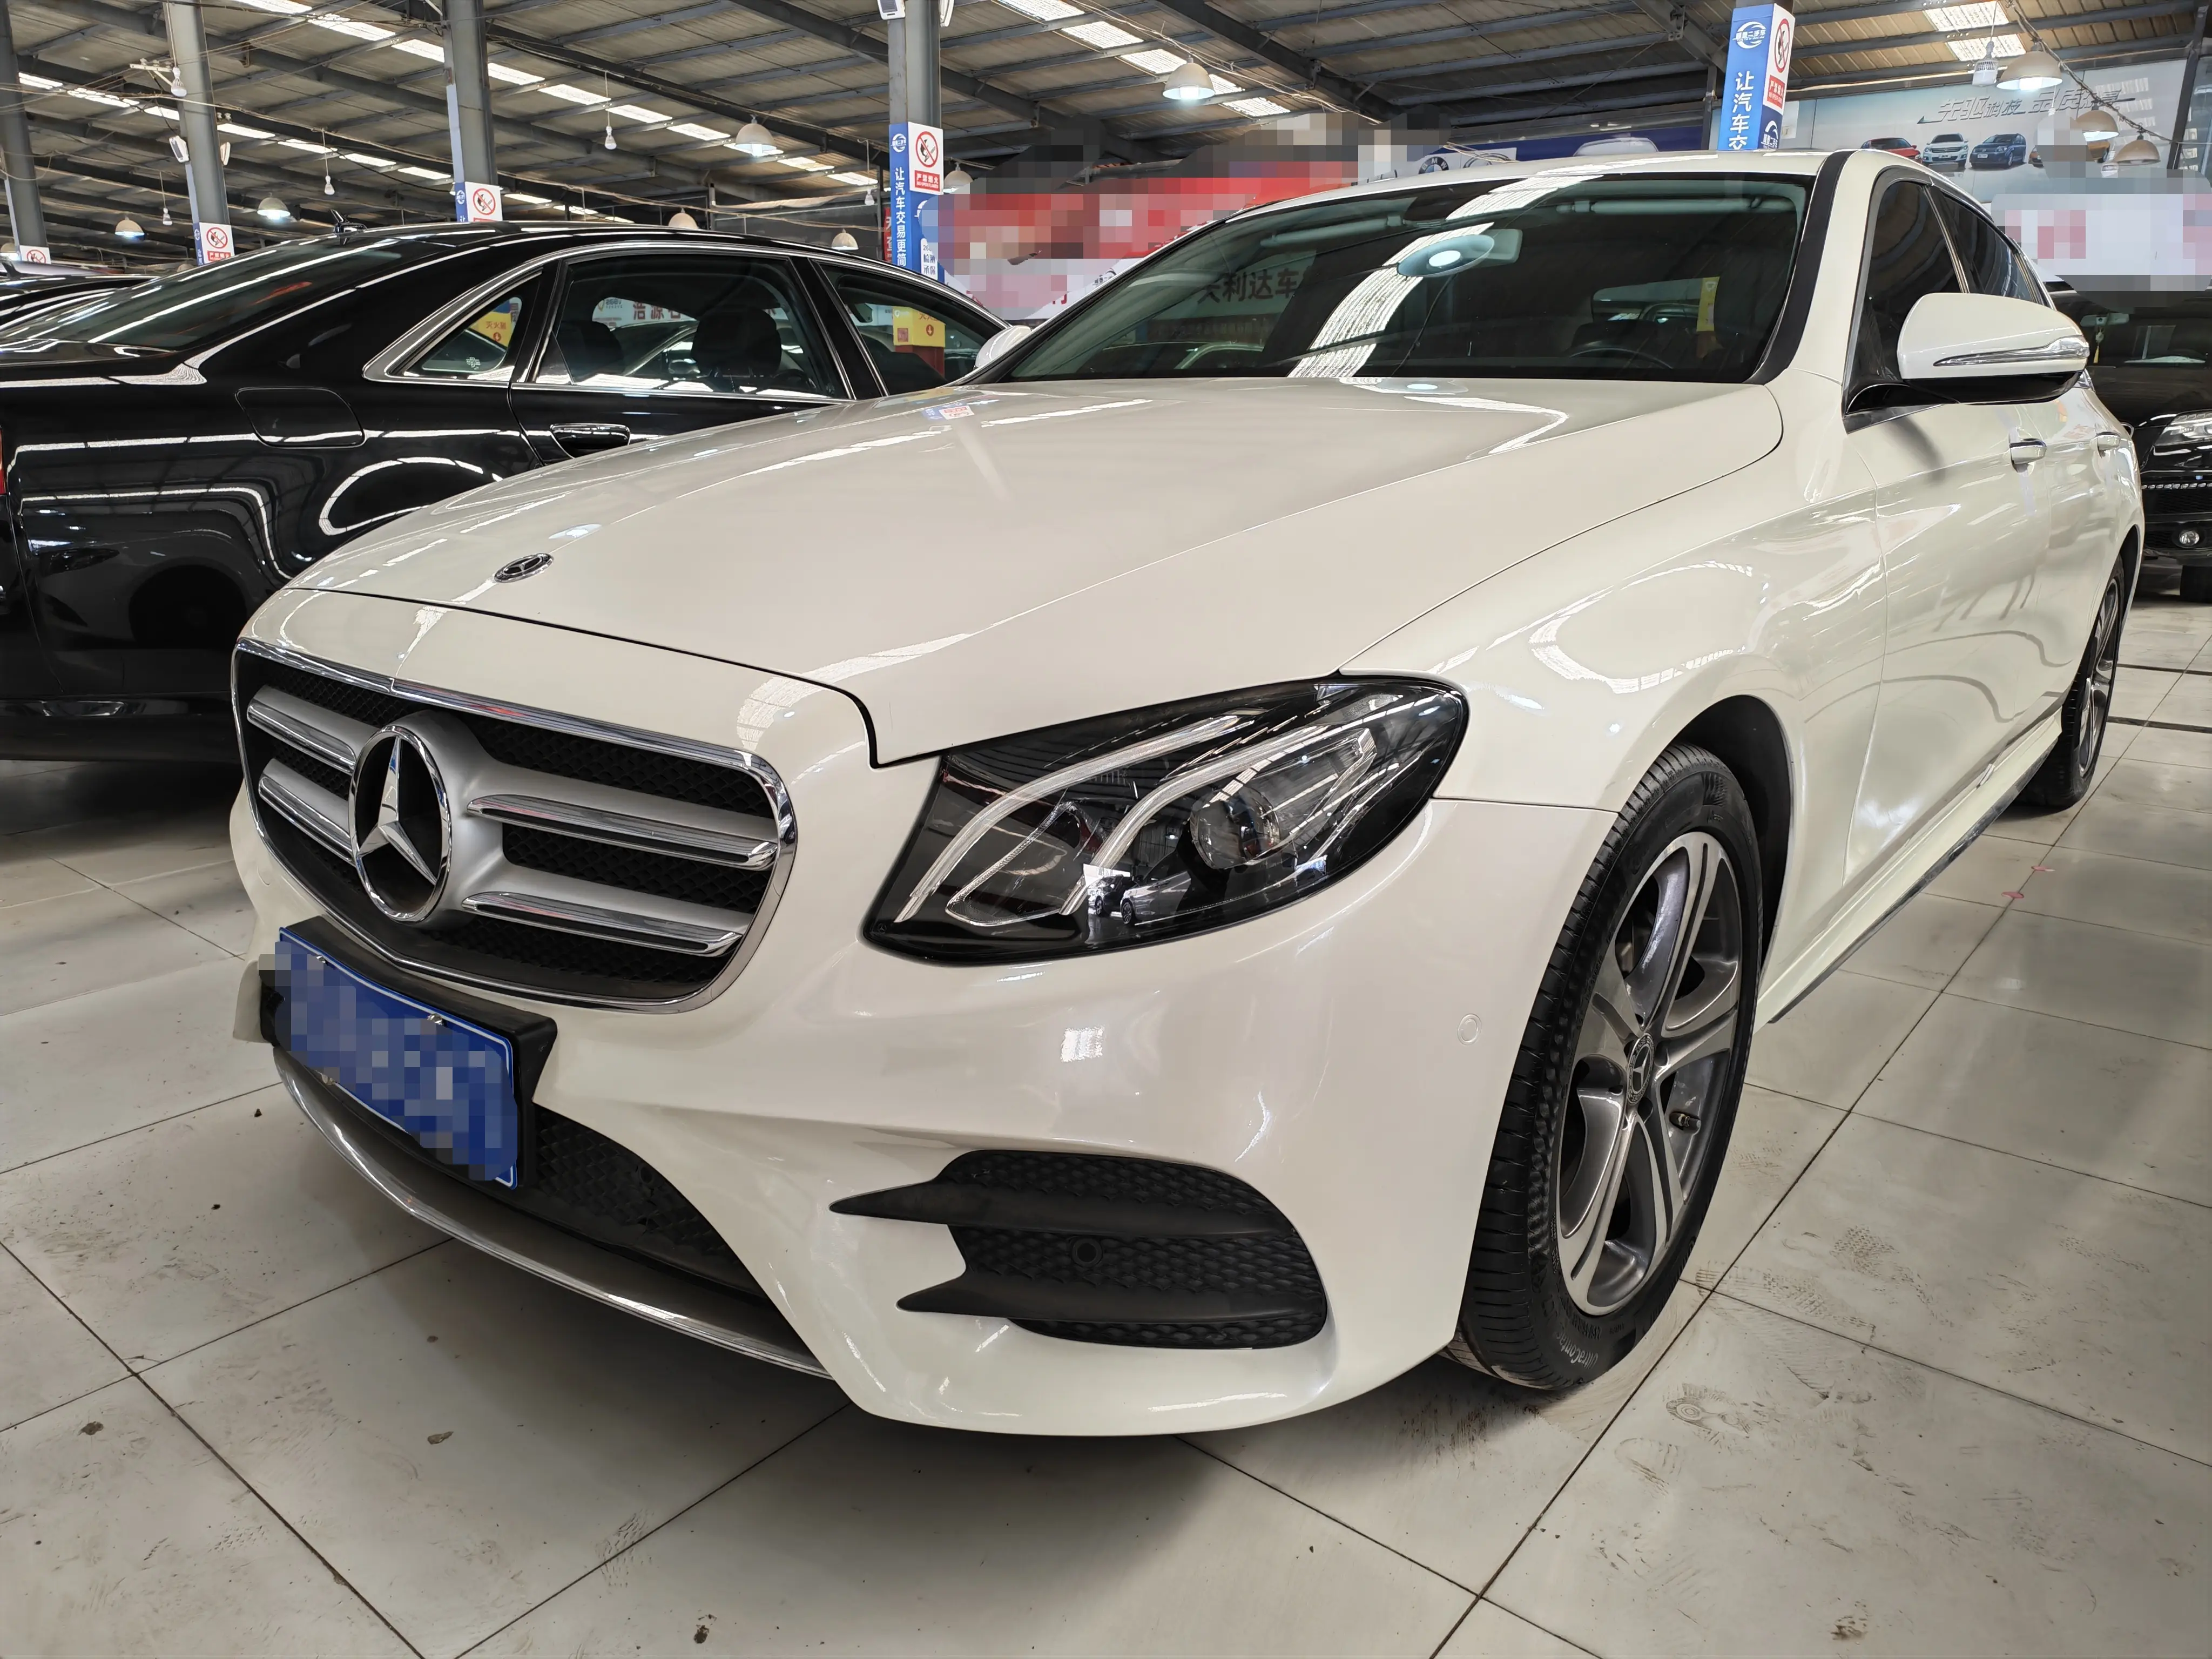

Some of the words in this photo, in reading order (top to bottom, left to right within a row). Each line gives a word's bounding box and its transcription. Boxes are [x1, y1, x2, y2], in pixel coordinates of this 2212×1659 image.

[1729, 71, 1754, 150] 让汽车交
[1937, 96, 2024, 121] 先驱科技
[1422, 158, 1447, 170] BMW
[894, 167, 906, 267] 让汽车交易更简
